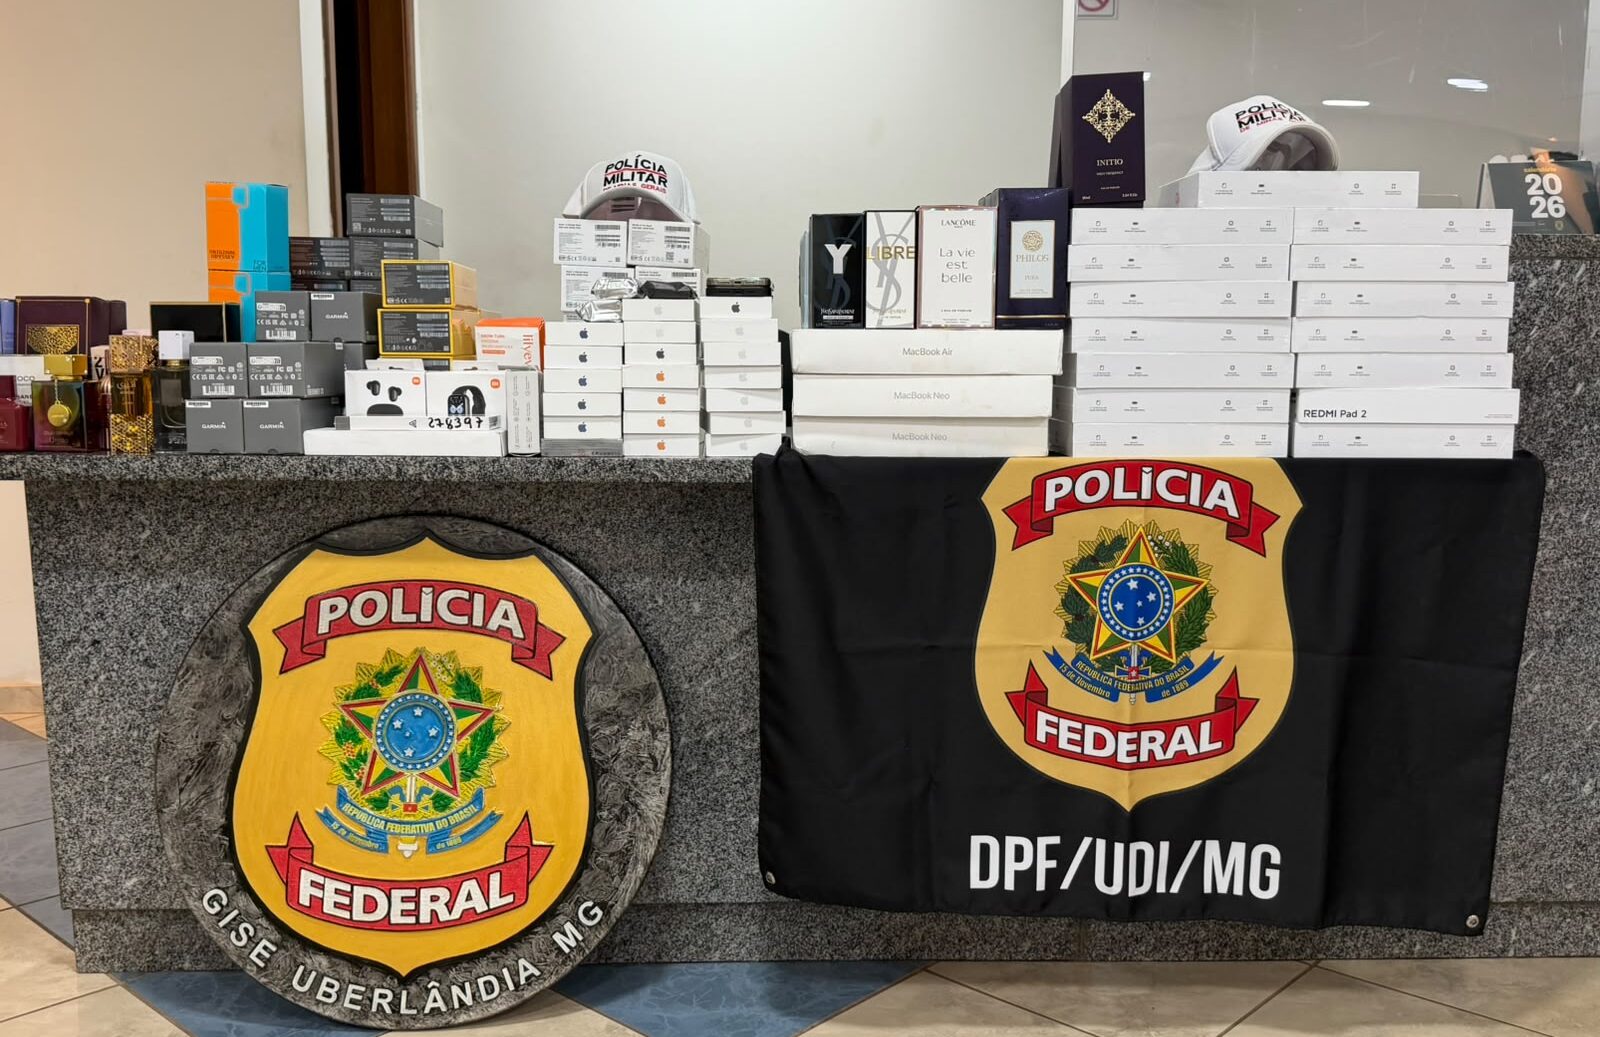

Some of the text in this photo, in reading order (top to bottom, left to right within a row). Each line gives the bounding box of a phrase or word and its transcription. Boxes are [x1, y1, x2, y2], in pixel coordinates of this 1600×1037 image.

[605, 154, 667, 174] POLÍCIA
[1096, 158, 1124, 166] INITIO
[603, 171, 668, 188] MILITAR
[1524, 173, 1562, 195] 20
[1529, 195, 1566, 218] 26
[940, 218, 977, 226] LANCÔME
[866, 246, 915, 260] LIBRE
[939, 247, 976, 257] La vie
[945, 261, 968, 270] est
[941, 272, 973, 283] belle
[902, 347, 953, 356] MacBook Air
[893, 391, 950, 400] MacBook Neo
[1303, 409, 1367, 418] REDMI Pad 2
[892, 432, 948, 441] MacBook Neo
[1044, 466, 1240, 519] POLÍCIA
[317, 587, 526, 640] POLÍCIA
[1065, 669, 1075, 679] de
[1161, 690, 1171, 698] de
[1154, 677, 1165, 686] DO
[1165, 664, 1191, 683] BRASIL
[1036, 710, 1222, 763] FEDERAL
[436, 818, 448, 829] DO
[449, 804, 479, 825] BRASIL
[969, 835, 1282, 900] DPF/UDI/MG
[298, 868, 515, 924] FEDERAL
[201, 887, 603, 1016] GISE UBERLÂNDIA MG
